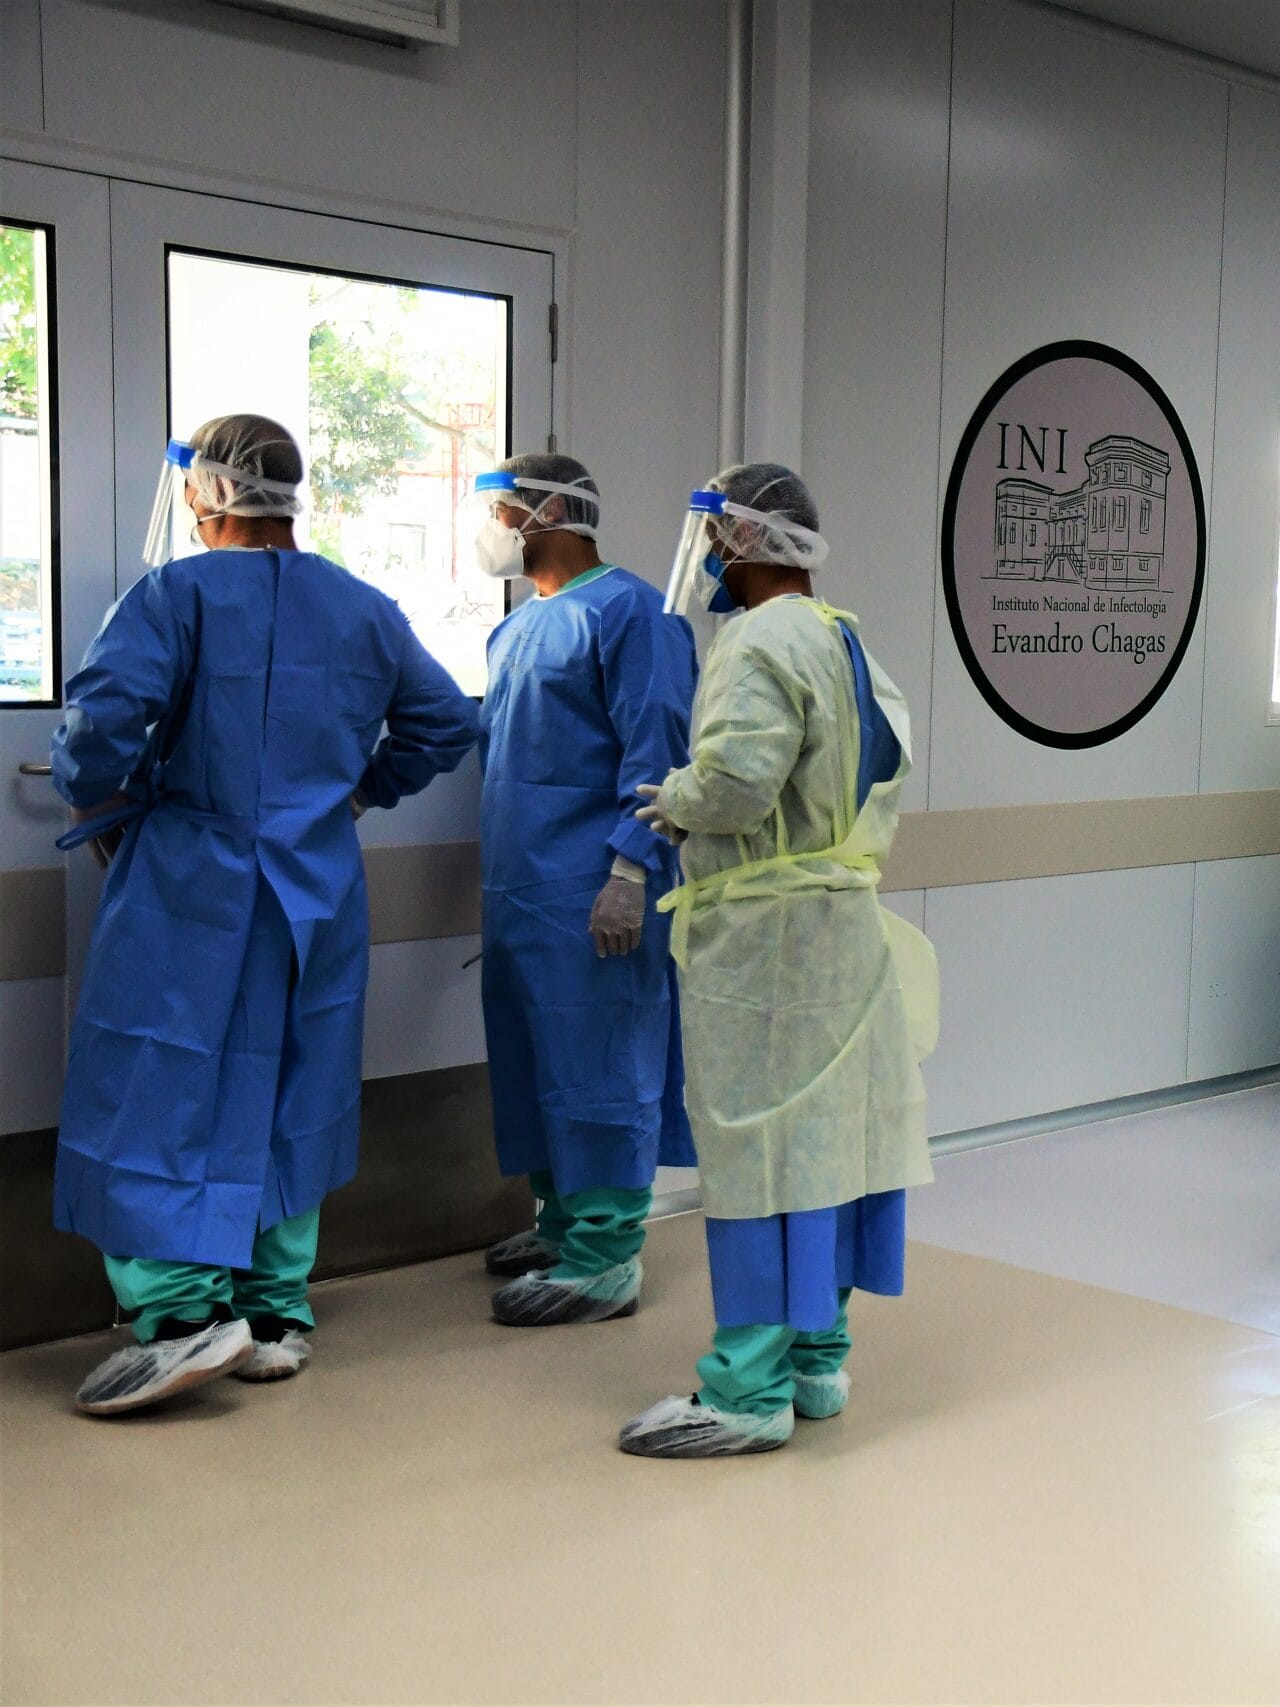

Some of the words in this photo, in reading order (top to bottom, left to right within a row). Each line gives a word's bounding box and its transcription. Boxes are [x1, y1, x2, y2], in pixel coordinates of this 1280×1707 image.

[997, 423, 1069, 474] INI
[992, 596, 1040, 612] Instituto
[1043, 596, 1090, 613] Nacional
[1093, 597, 1106, 613] de
[1109, 597, 1167, 619] Infectologia
[991, 621, 1084, 653] Evandro
[1092, 622, 1166, 664] Chagas
